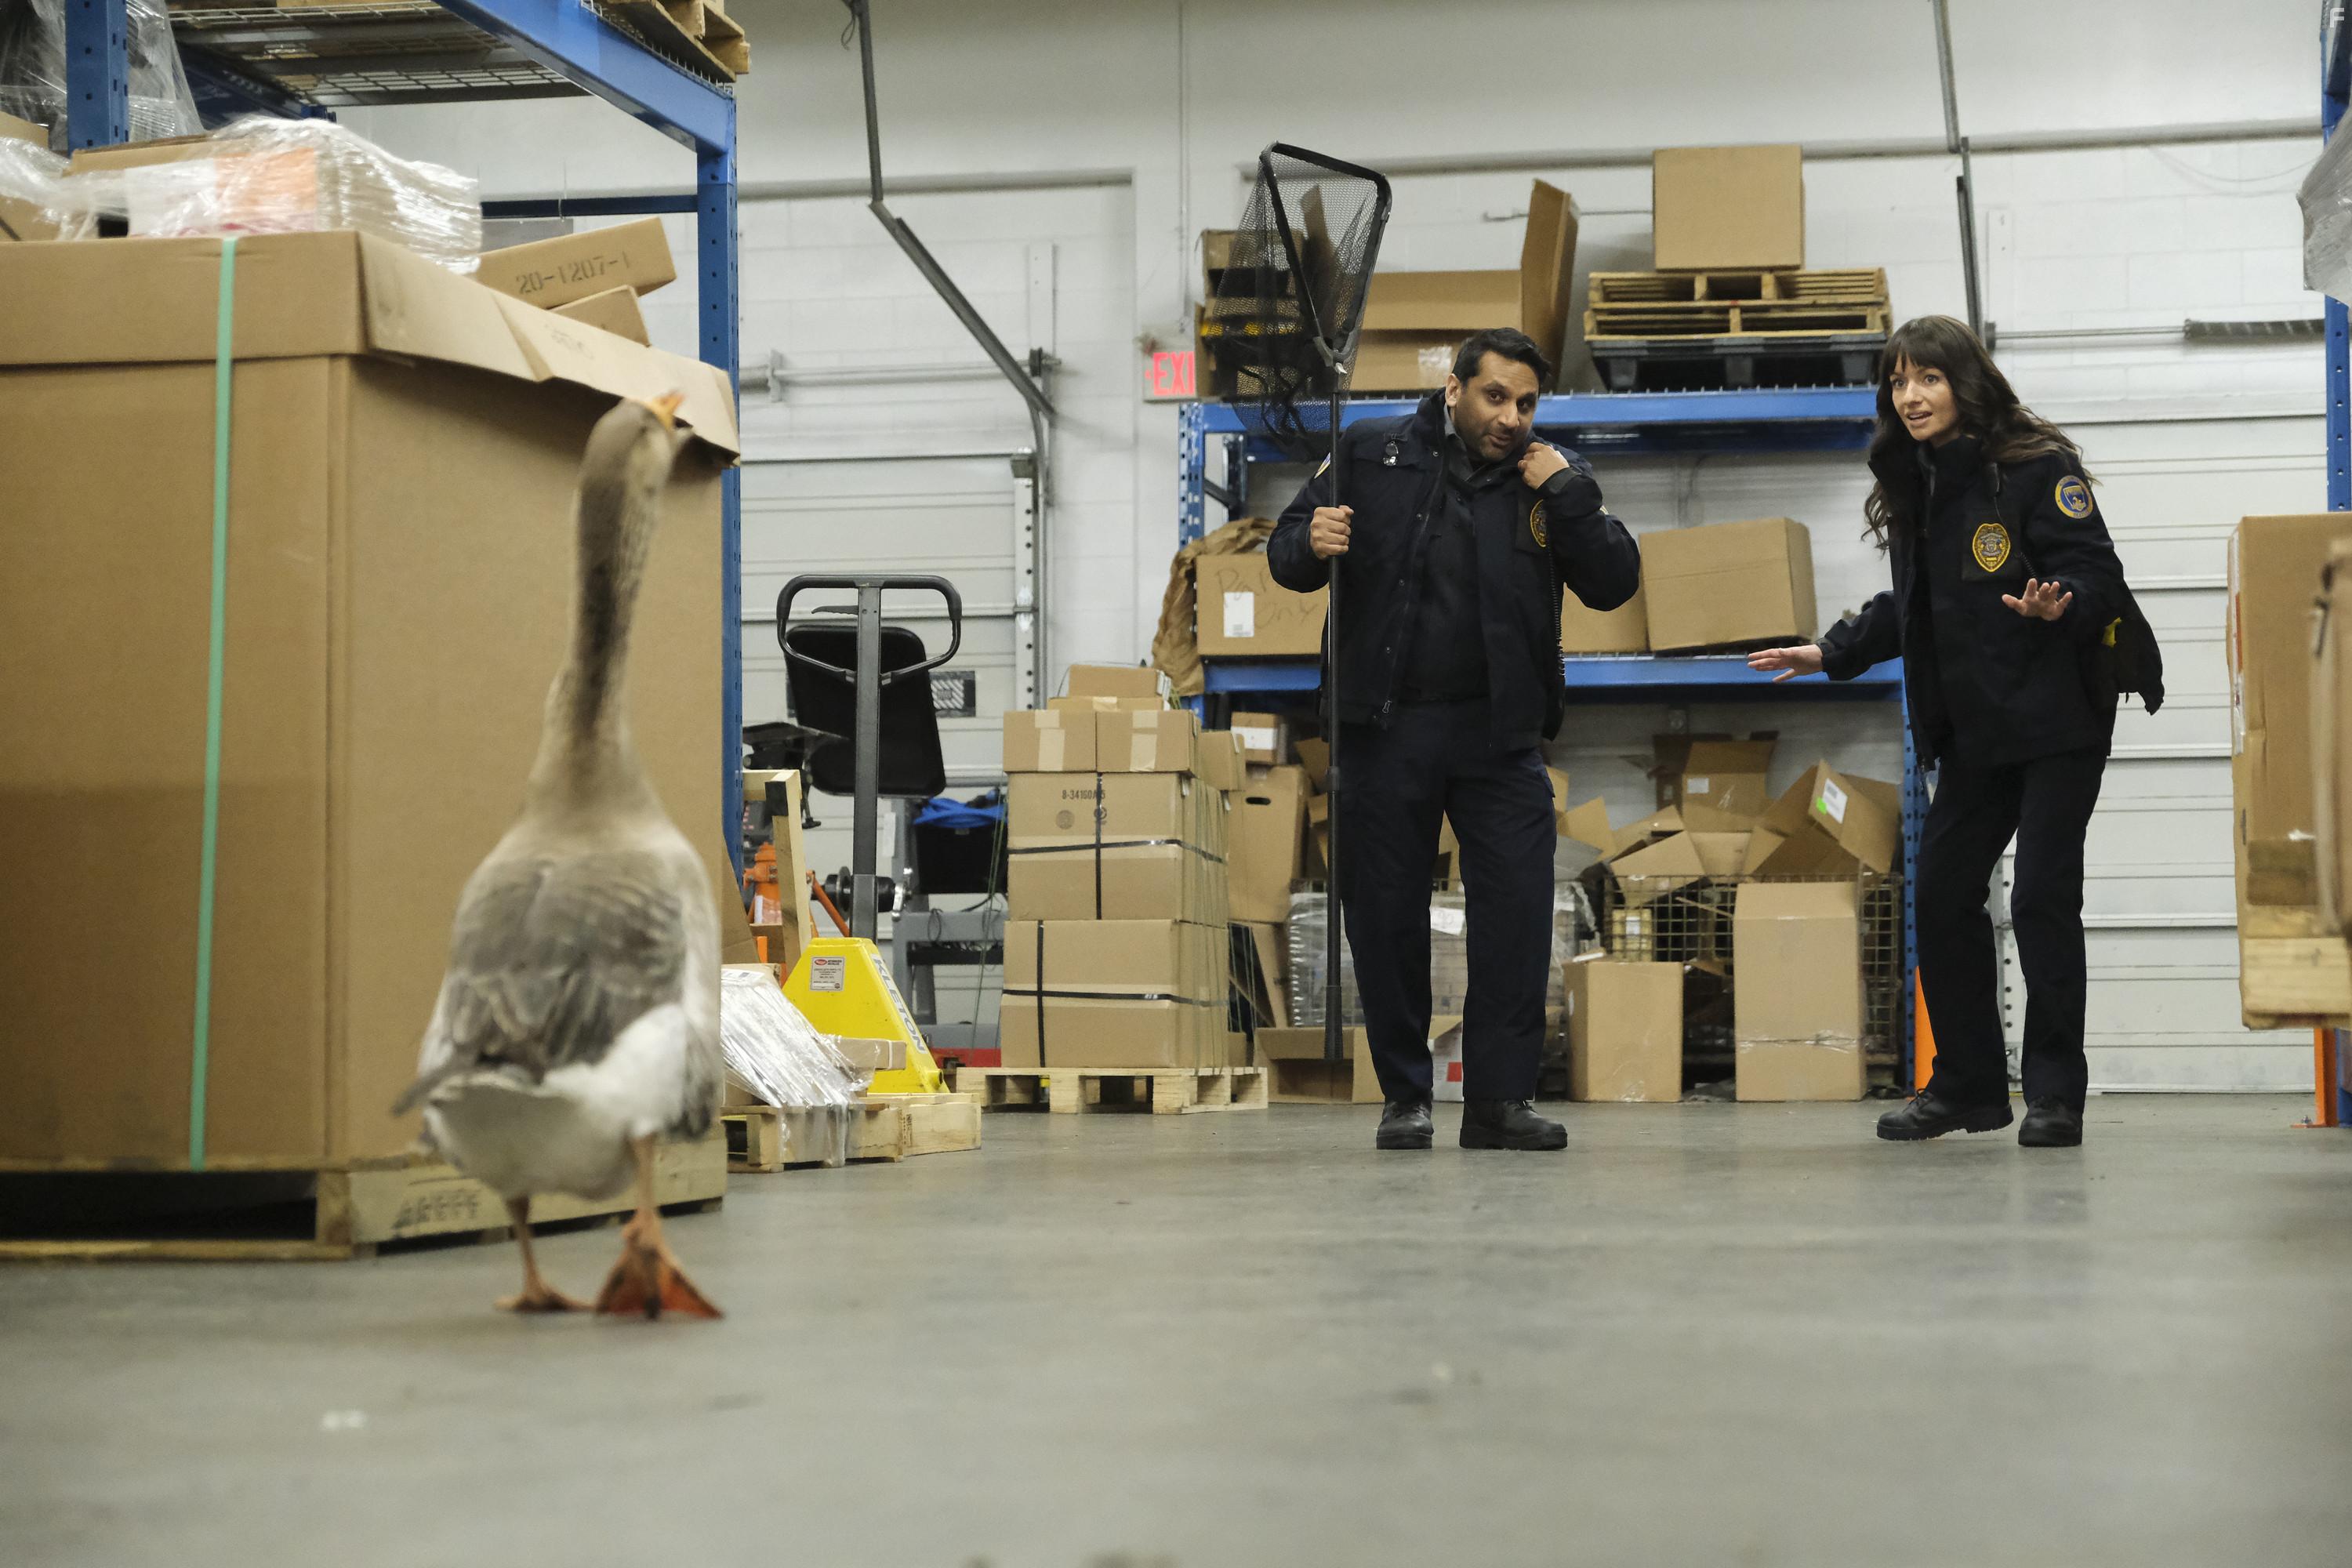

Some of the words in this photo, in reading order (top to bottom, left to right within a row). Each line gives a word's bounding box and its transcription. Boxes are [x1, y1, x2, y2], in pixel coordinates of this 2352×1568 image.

[517, 251, 630, 294] 20-1207-1
[1153, 350, 1195, 396] EXI
[873, 958, 926, 1051] KLETON
